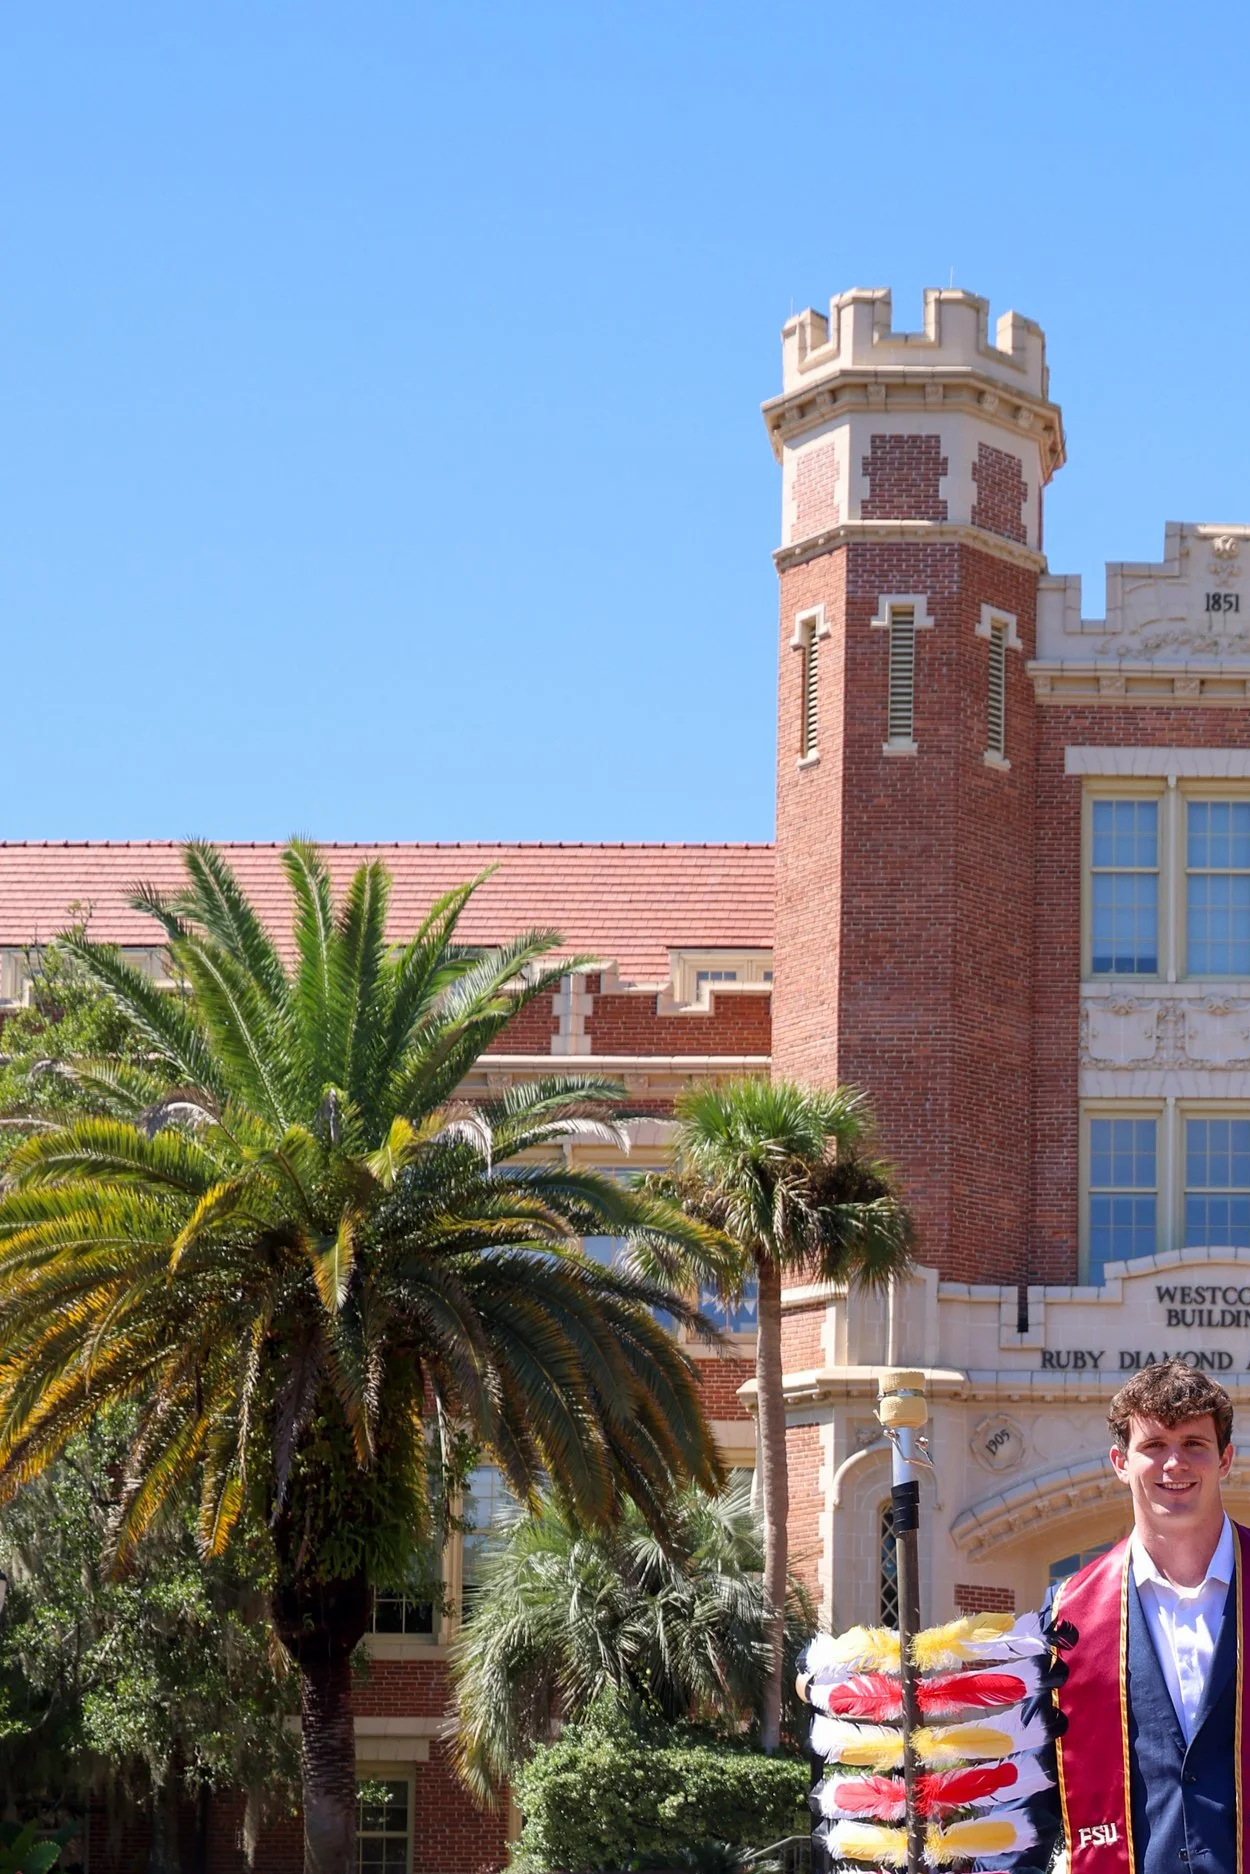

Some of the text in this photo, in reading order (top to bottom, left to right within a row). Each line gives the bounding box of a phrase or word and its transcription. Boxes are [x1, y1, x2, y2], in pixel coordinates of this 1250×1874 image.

[1205, 592, 1239, 612] 1851
[1041, 1350, 1105, 1369] RUBY
[986, 1429, 1009, 1456] 1905
[1078, 1823, 1118, 1848] FSU
